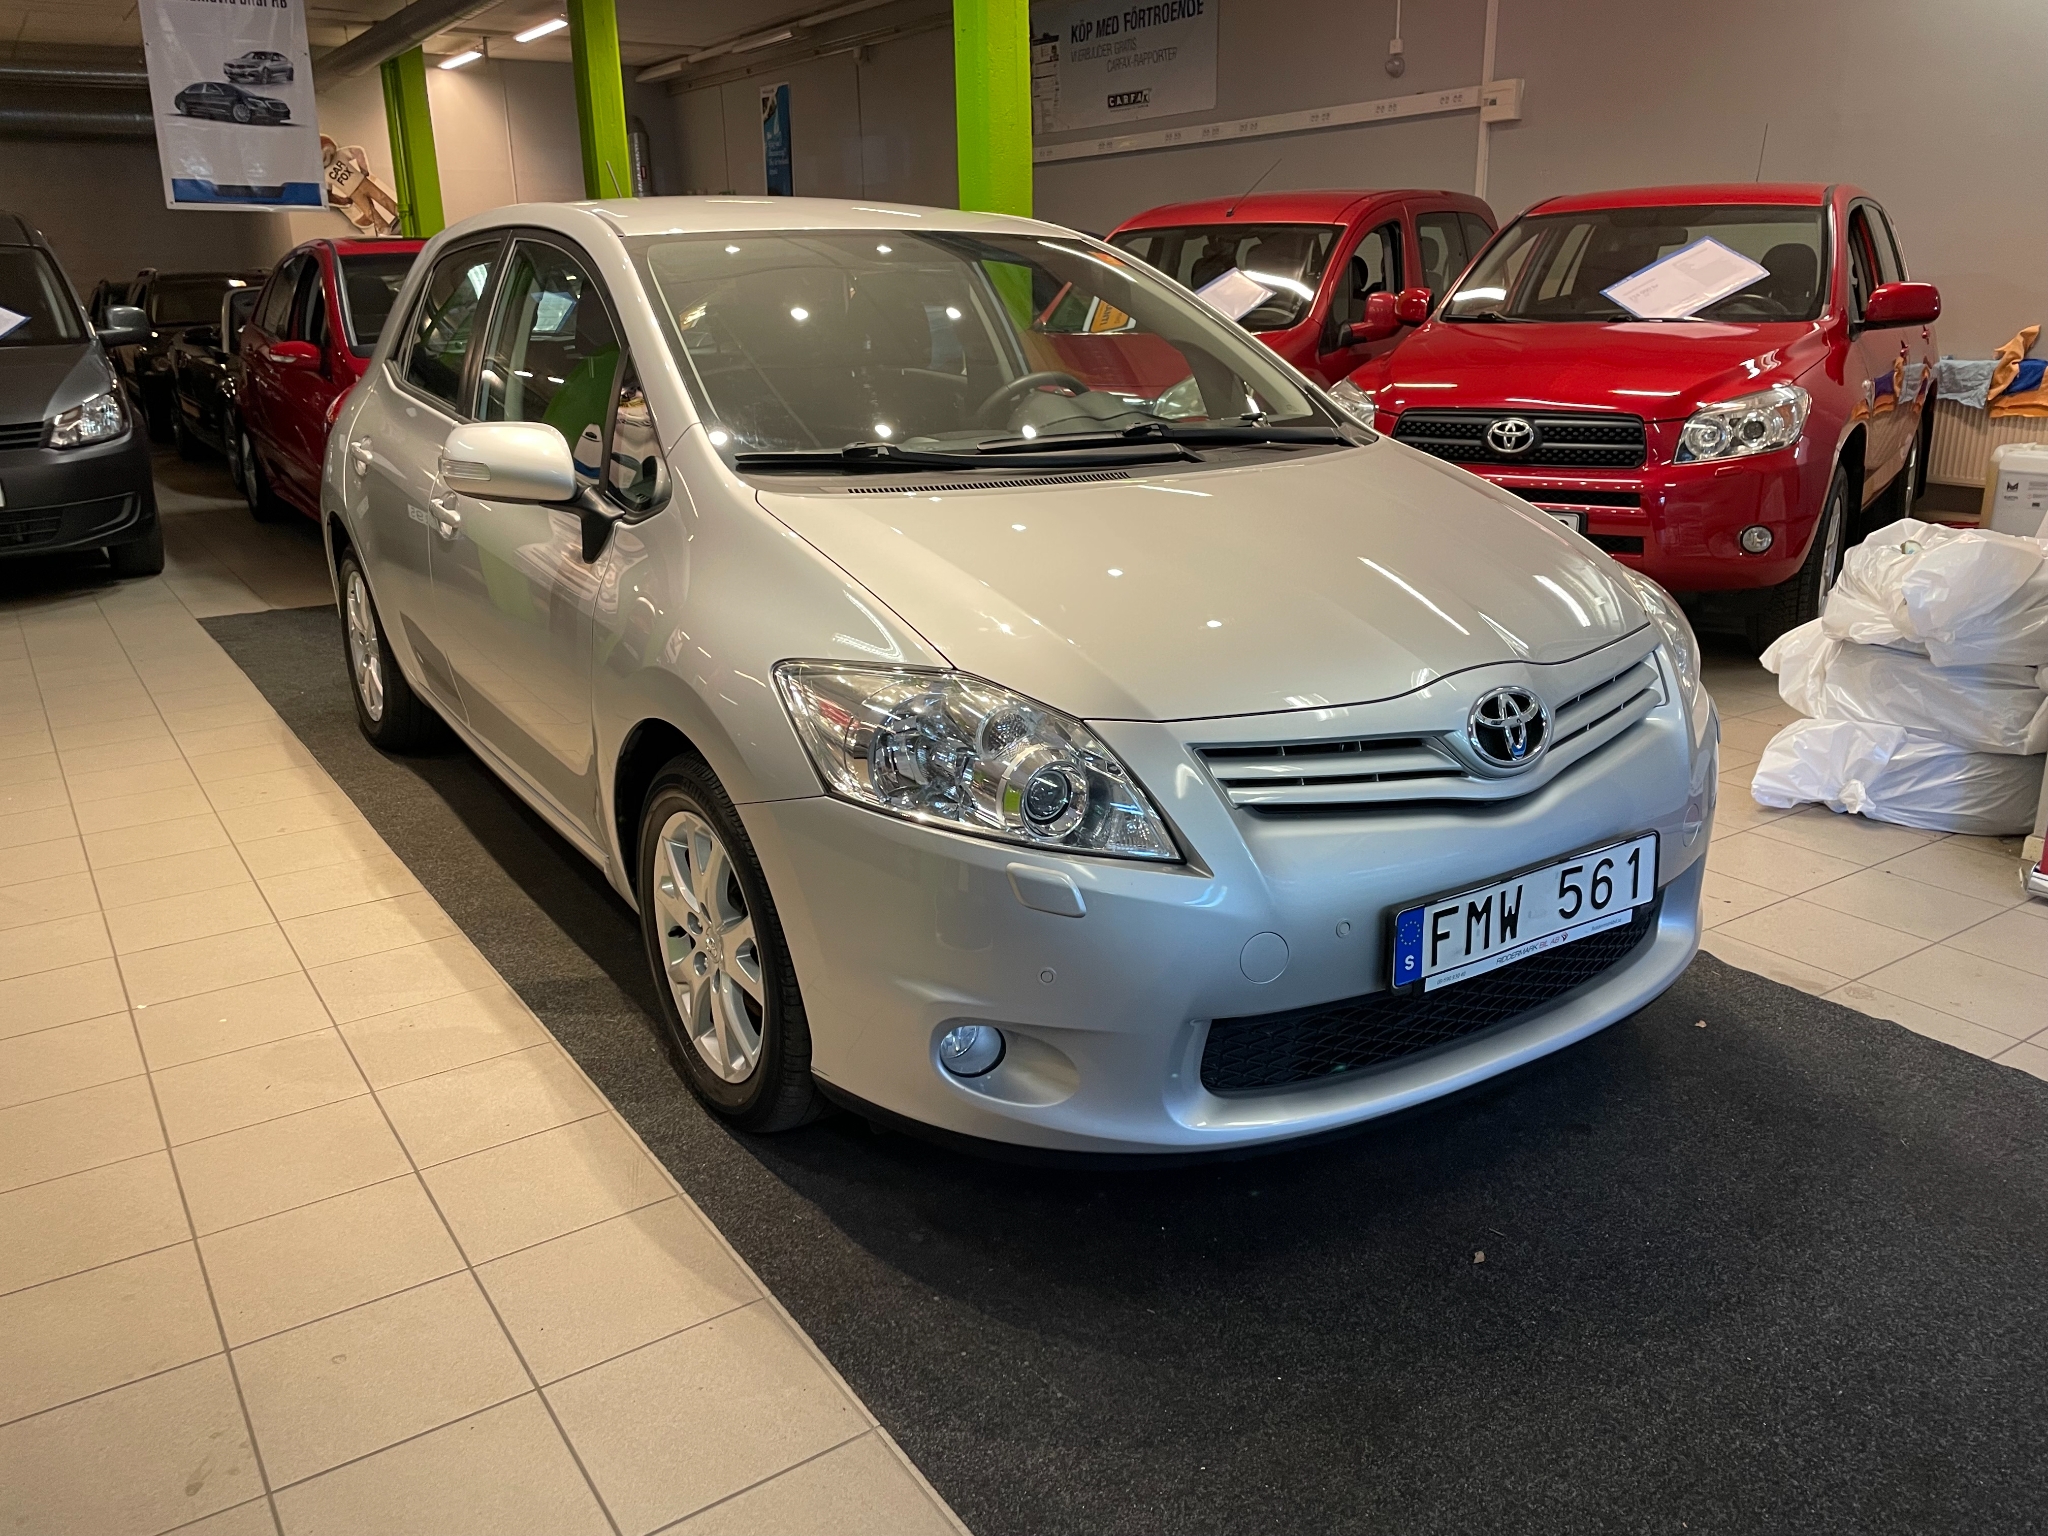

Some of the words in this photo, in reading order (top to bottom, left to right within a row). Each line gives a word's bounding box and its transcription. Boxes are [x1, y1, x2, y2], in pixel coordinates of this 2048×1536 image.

[1070, 18, 1093, 44] KÖP
[1096, 15, 1119, 39] MED
[1123, 0, 1204, 32] FÖRTROENDE
[329, 160, 346, 180] CAR
[336, 167, 354, 186] FOX
[1430, 884, 1524, 968] FMW
[1557, 847, 1642, 920] 561
[1404, 954, 1415, 971] S
[1495, 944, 1539, 966] RIDDERMARK
